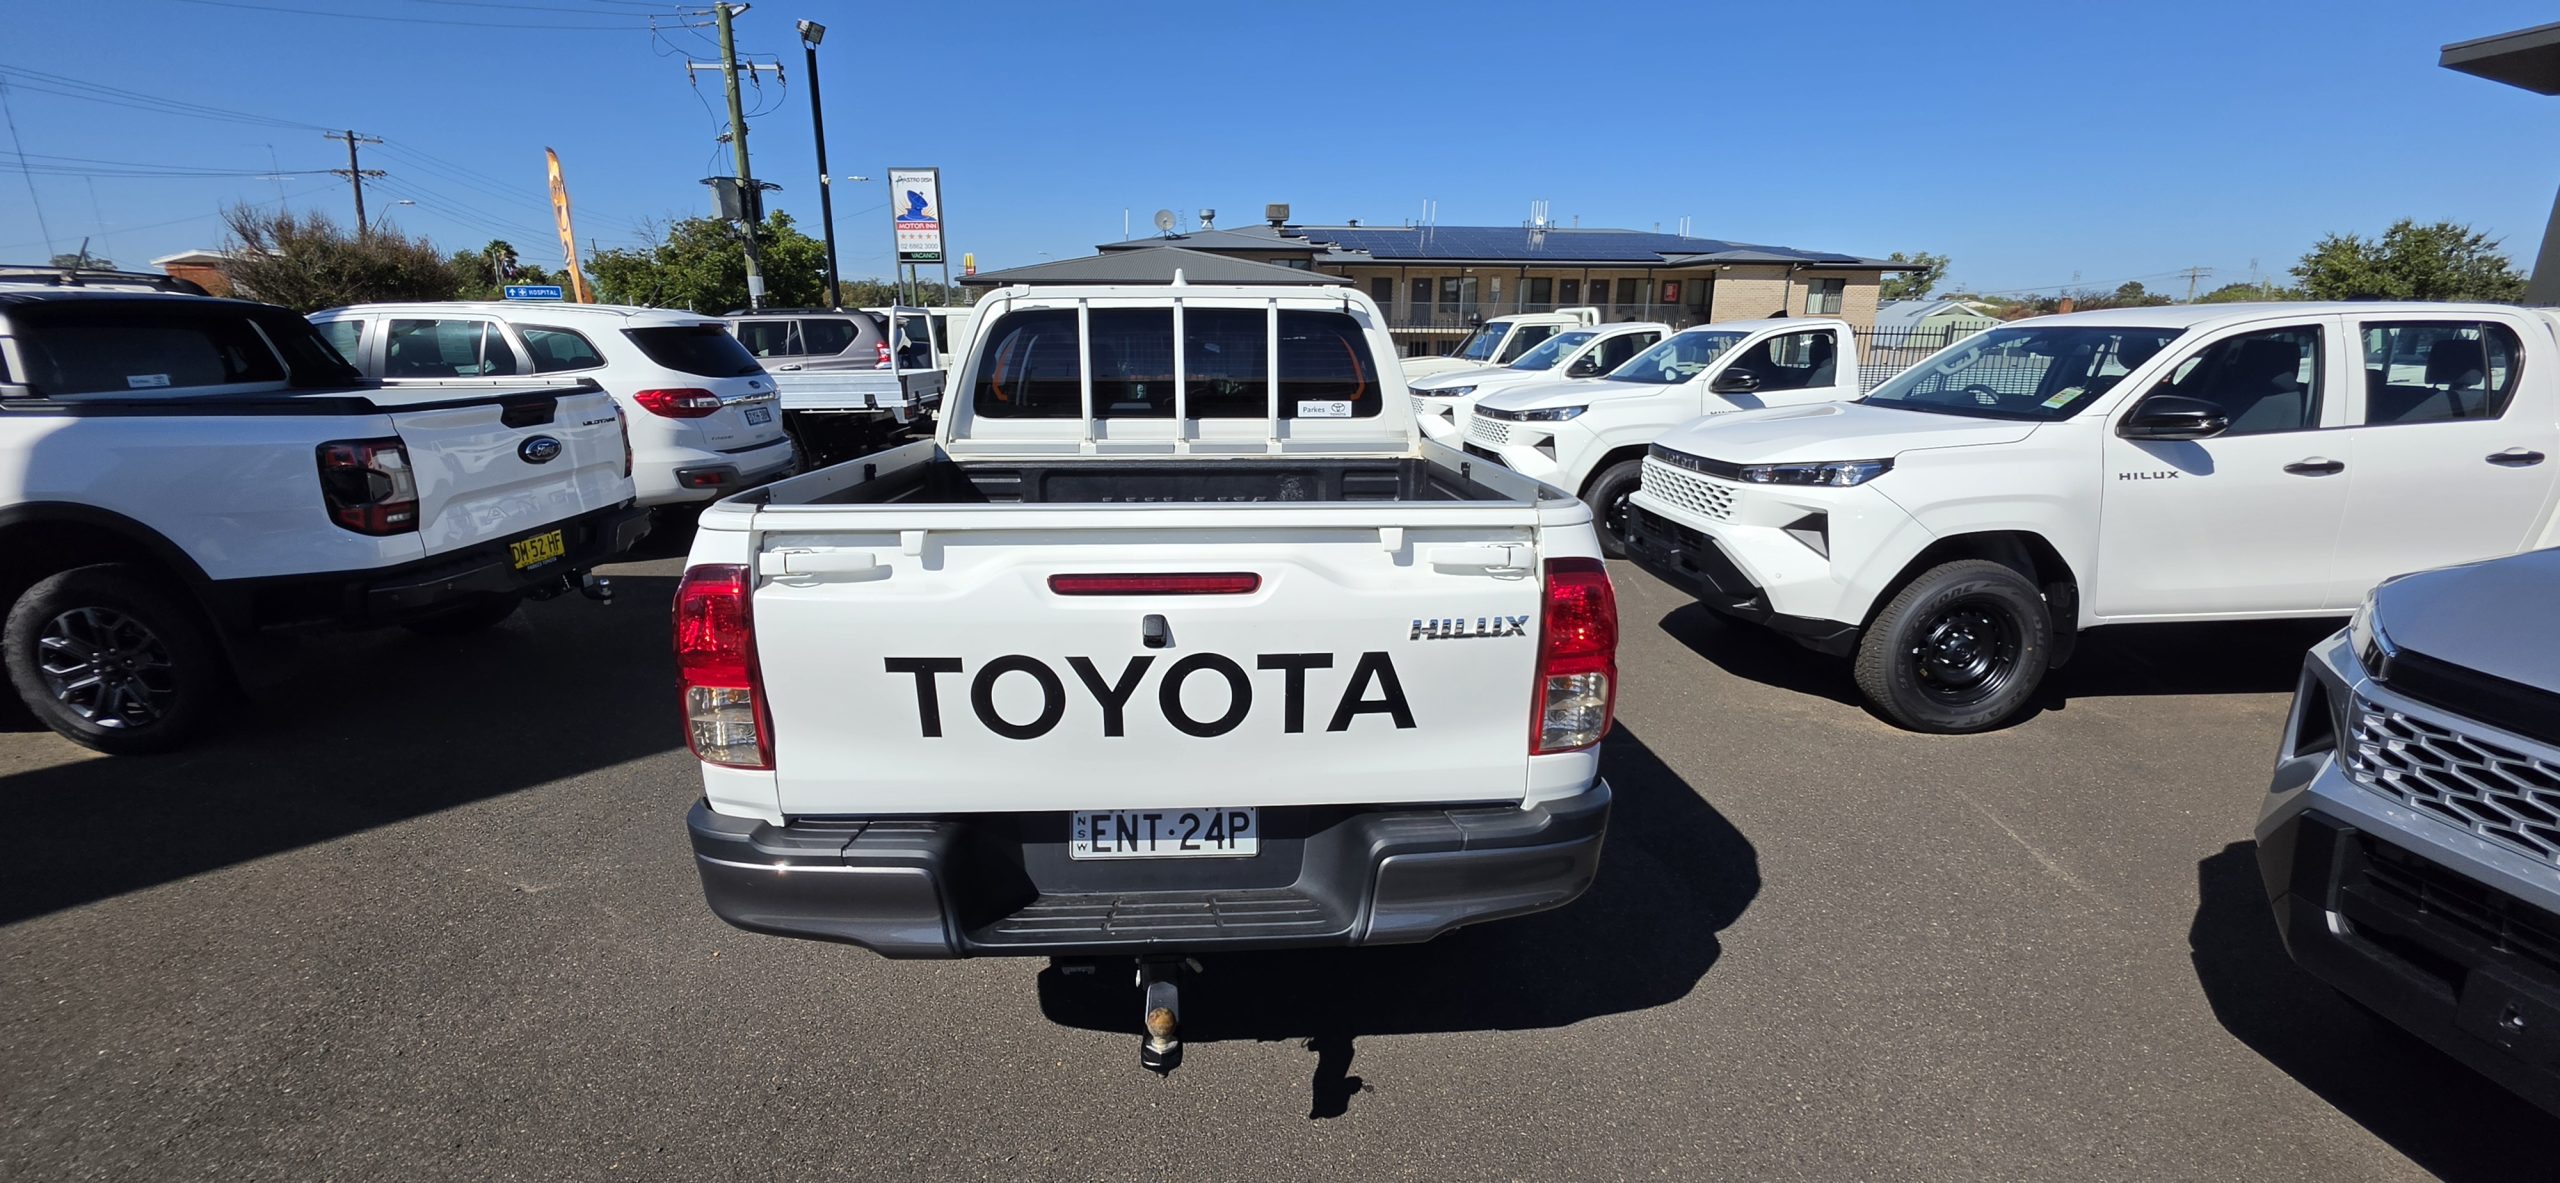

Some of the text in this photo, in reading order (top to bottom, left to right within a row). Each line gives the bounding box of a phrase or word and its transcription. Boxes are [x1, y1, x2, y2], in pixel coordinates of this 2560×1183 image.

[2118, 470, 2180, 481] HILUX
[1409, 615, 1530, 641] HILUX
[883, 651, 1418, 741] TOYOTA
